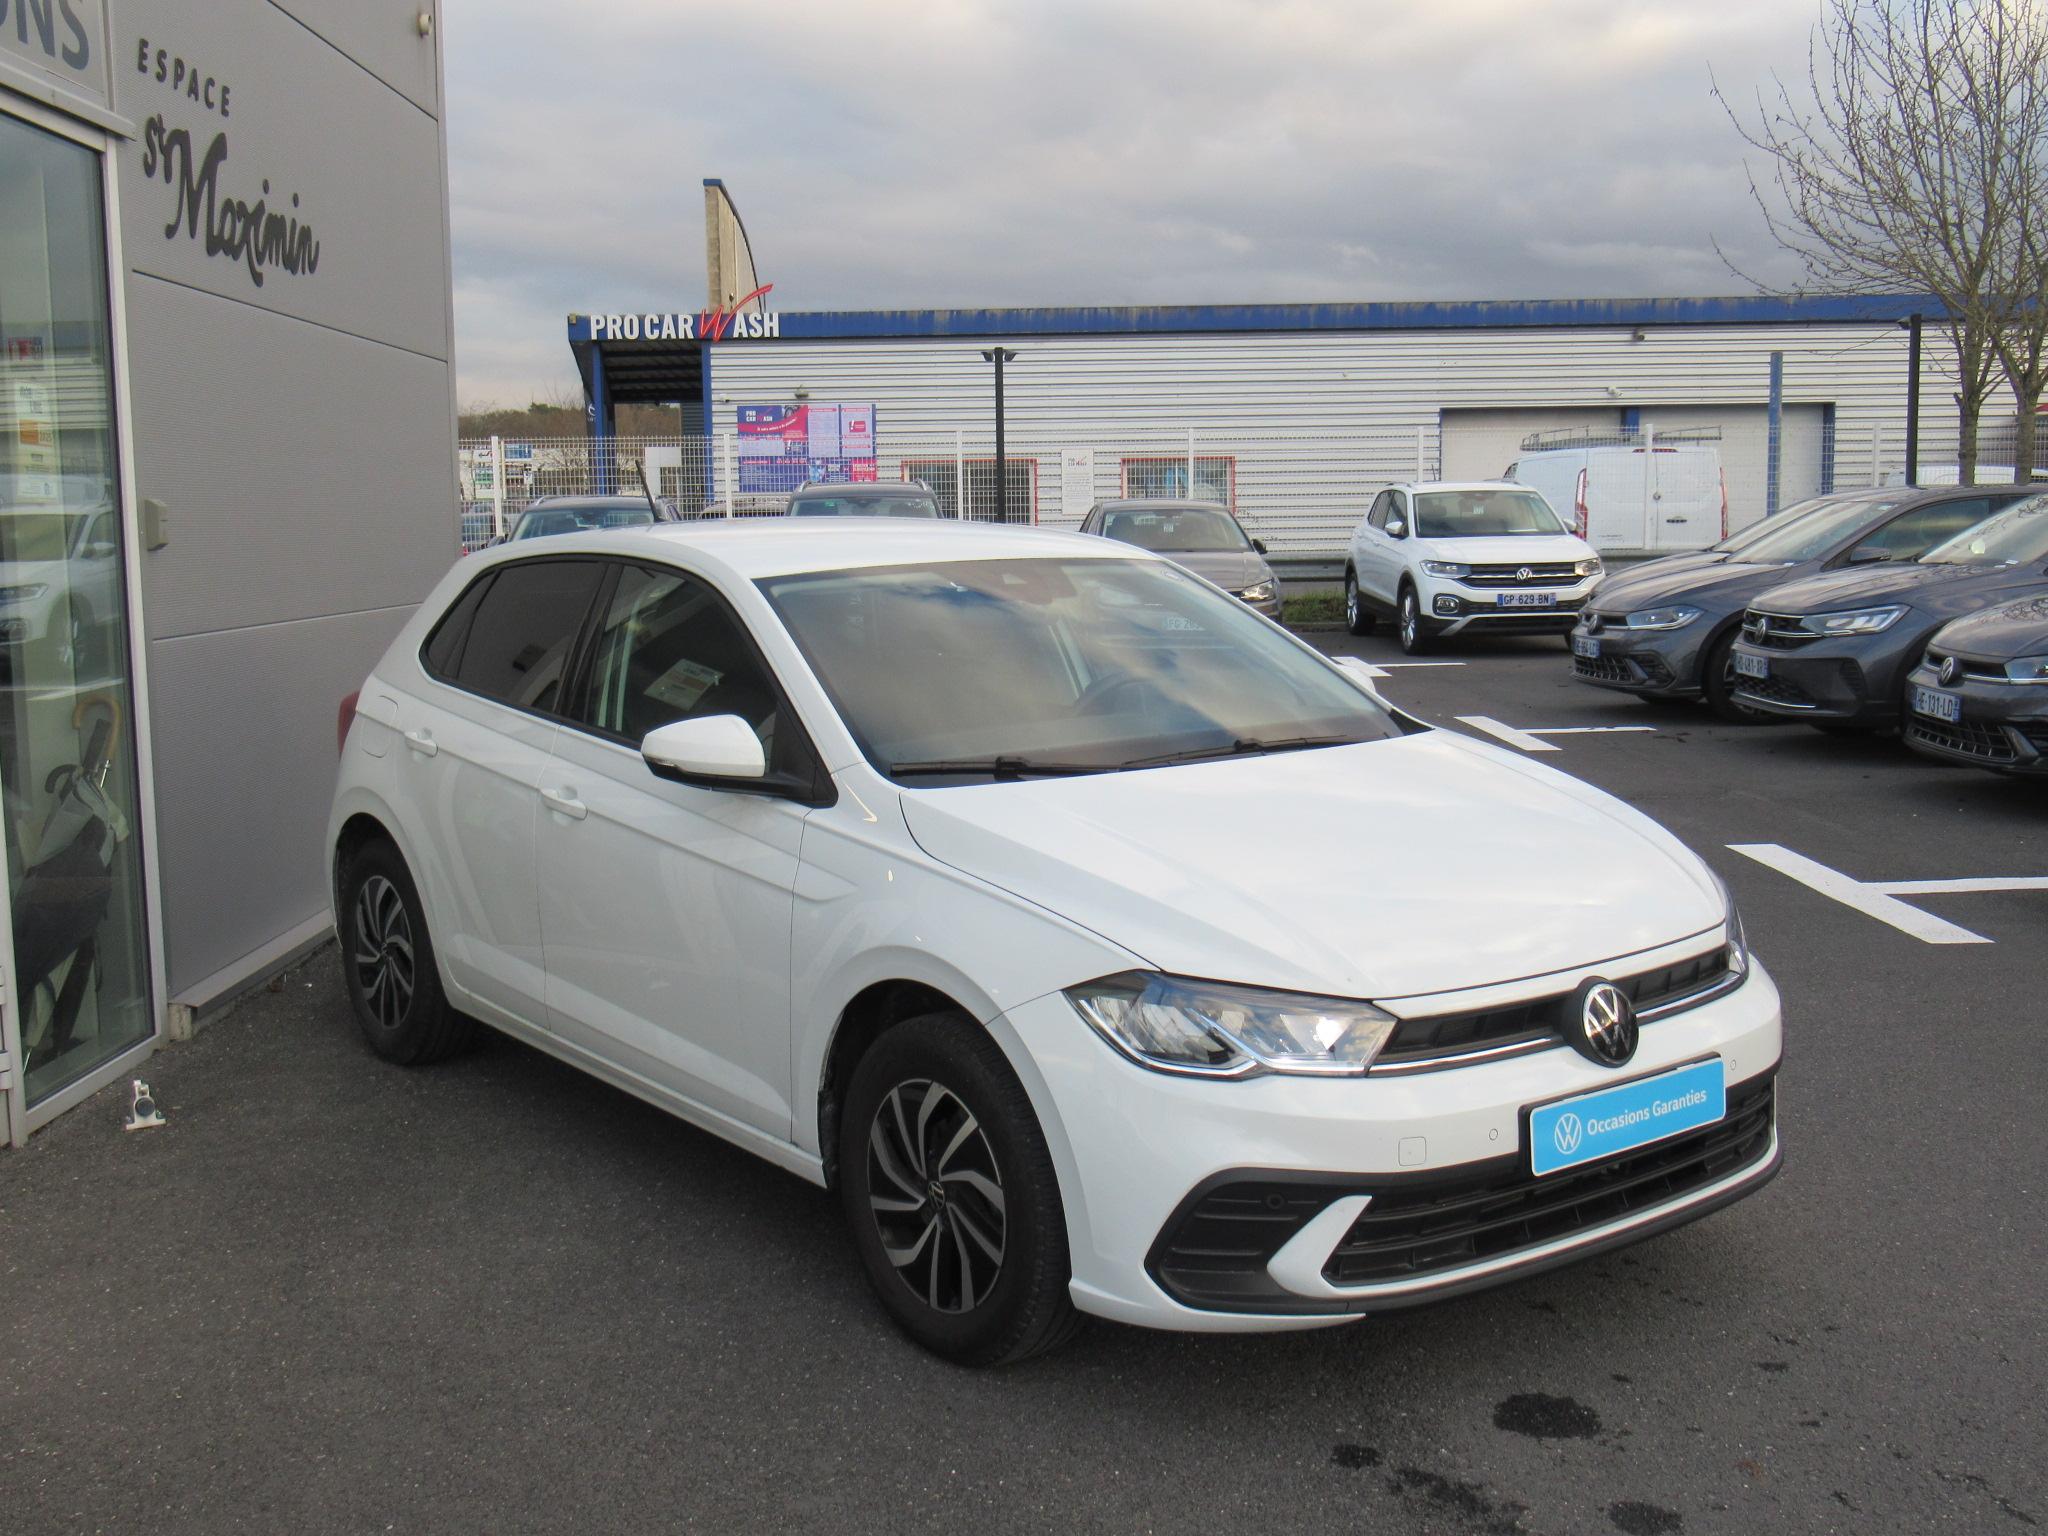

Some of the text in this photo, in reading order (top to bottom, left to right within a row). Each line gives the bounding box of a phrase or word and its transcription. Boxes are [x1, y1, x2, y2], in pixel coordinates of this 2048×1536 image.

[0, 0, 89, 70] NS
[138, 38, 230, 117] ESPACE
[165, 128, 319, 287] Maximin
[590, 314, 640, 340] PRO
[645, 313, 694, 340] CAR
[1587, 1108, 1650, 1136] Occasions
[1652, 1090, 1707, 1117] Garanties
